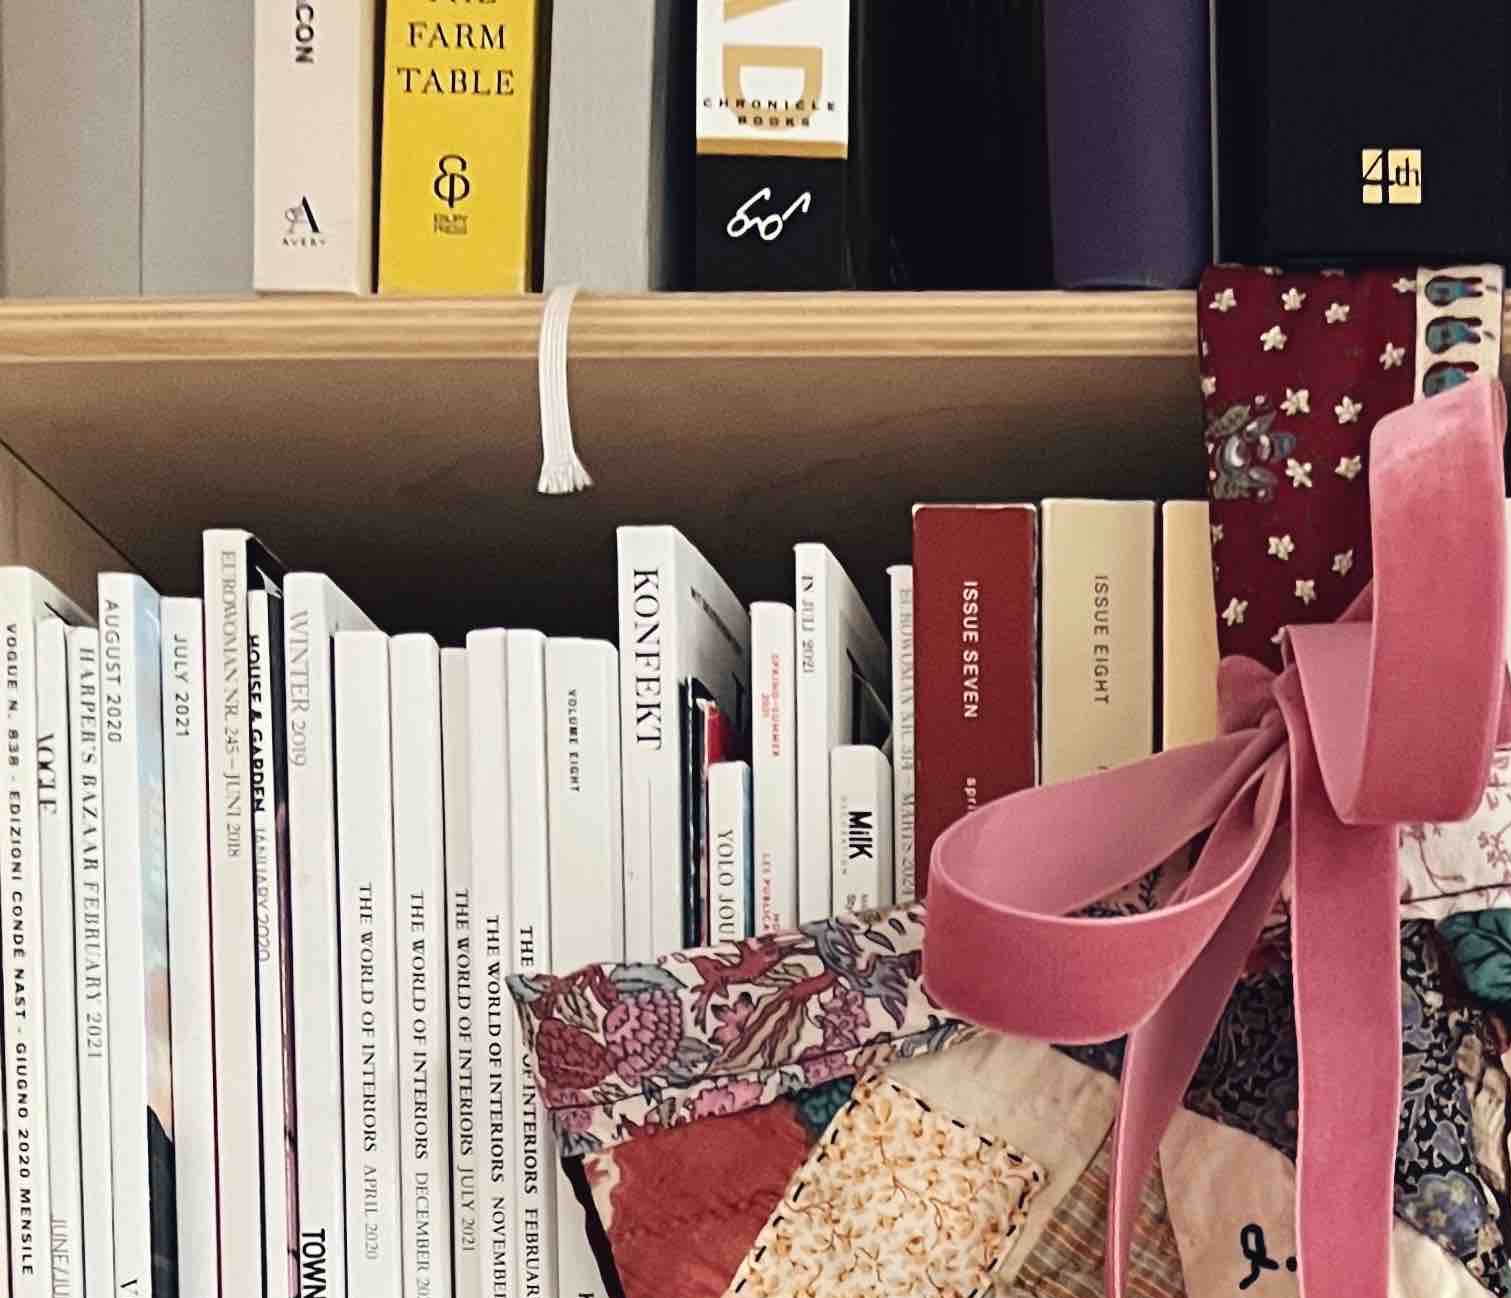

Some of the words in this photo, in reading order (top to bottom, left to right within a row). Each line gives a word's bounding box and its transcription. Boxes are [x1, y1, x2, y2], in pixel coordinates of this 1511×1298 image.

[408, 22, 504, 49] FARM
[397, 67, 515, 95] TABLE
[703, 99, 835, 112] CHRONICLE
[737, 116, 810, 127] BOOKS
[282, 237, 327, 248] AVERY
[221, 551, 238, 681] EUROWOMAN
[963, 582, 978, 642] ISSUE
[1094, 576, 1109, 635] ISSUE
[6, 624, 18, 689] VOGUE
[105, 601, 120, 684] AUGUST
[174, 634, 189, 682] JULY
[289, 610, 309, 712] WINTER
[632, 569, 662, 751] KONFEKT
[803, 640, 815, 674] 2021
[249, 634, 261, 703] HOUSE
[964, 651, 978, 718] SEVEN
[1095, 645, 1109, 704] EIGHT
[8, 700, 18, 719] N.
[79, 648, 96, 764] HARPER'S
[107, 695, 122, 743] 2020
[175, 693, 190, 737] 2021
[568, 689, 579, 743] VOLUME
[8, 730, 19, 766] 838
[225, 727, 239, 753] 245
[289, 720, 308, 766] 2019
[224, 771, 241, 817] JUNI
[250, 728, 264, 812] GARDEN
[569, 752, 580, 792] EIGHT
[9, 791, 23, 880] EDIZIONI
[82, 775, 99, 870] BAZAAR
[226, 824, 241, 857] 2018
[718, 830, 733, 887] YOLO
[358, 883, 373, 924] THE
[410, 890, 425, 931] THE
[455, 890, 469, 929] THE
[84, 881, 103, 1001] FEBRUARY
[486, 915, 500, 955] THE
[520, 927, 534, 966] THE
[359, 932, 374, 1003] WORLD
[410, 939, 427, 1011] WORLD
[455, 937, 472, 1009] WORLD
[14, 968, 26, 1020] NAST
[486, 962, 501, 1037] WORLD
[87, 1012, 103, 1059] 2021
[361, 1011, 375, 1037] OF
[413, 1019, 427, 1045] OF
[457, 1017, 472, 1043] OF
[15, 1043, 28, 1118] GIUGNO
[488, 1043, 502, 1068] OF
[362, 1044, 378, 1151] INTERIORS
[414, 1052, 429, 1159] INTERIORS
[458, 1049, 474, 1156] INTERIORS
[18, 1129, 31, 1178] 2020
[489, 1074, 505, 1183] INTERIORS
[522, 1084, 538, 1194] INTERIORS
[363, 1165, 378, 1216] APRIL
[456, 1166, 475, 1211] JULY
[20, 1189, 34, 1275] MENSILE
[365, 1224, 380, 1259] 2020
[414, 1172, 431, 1271] DECEMBER
[461, 1217, 476, 1251] 2021
